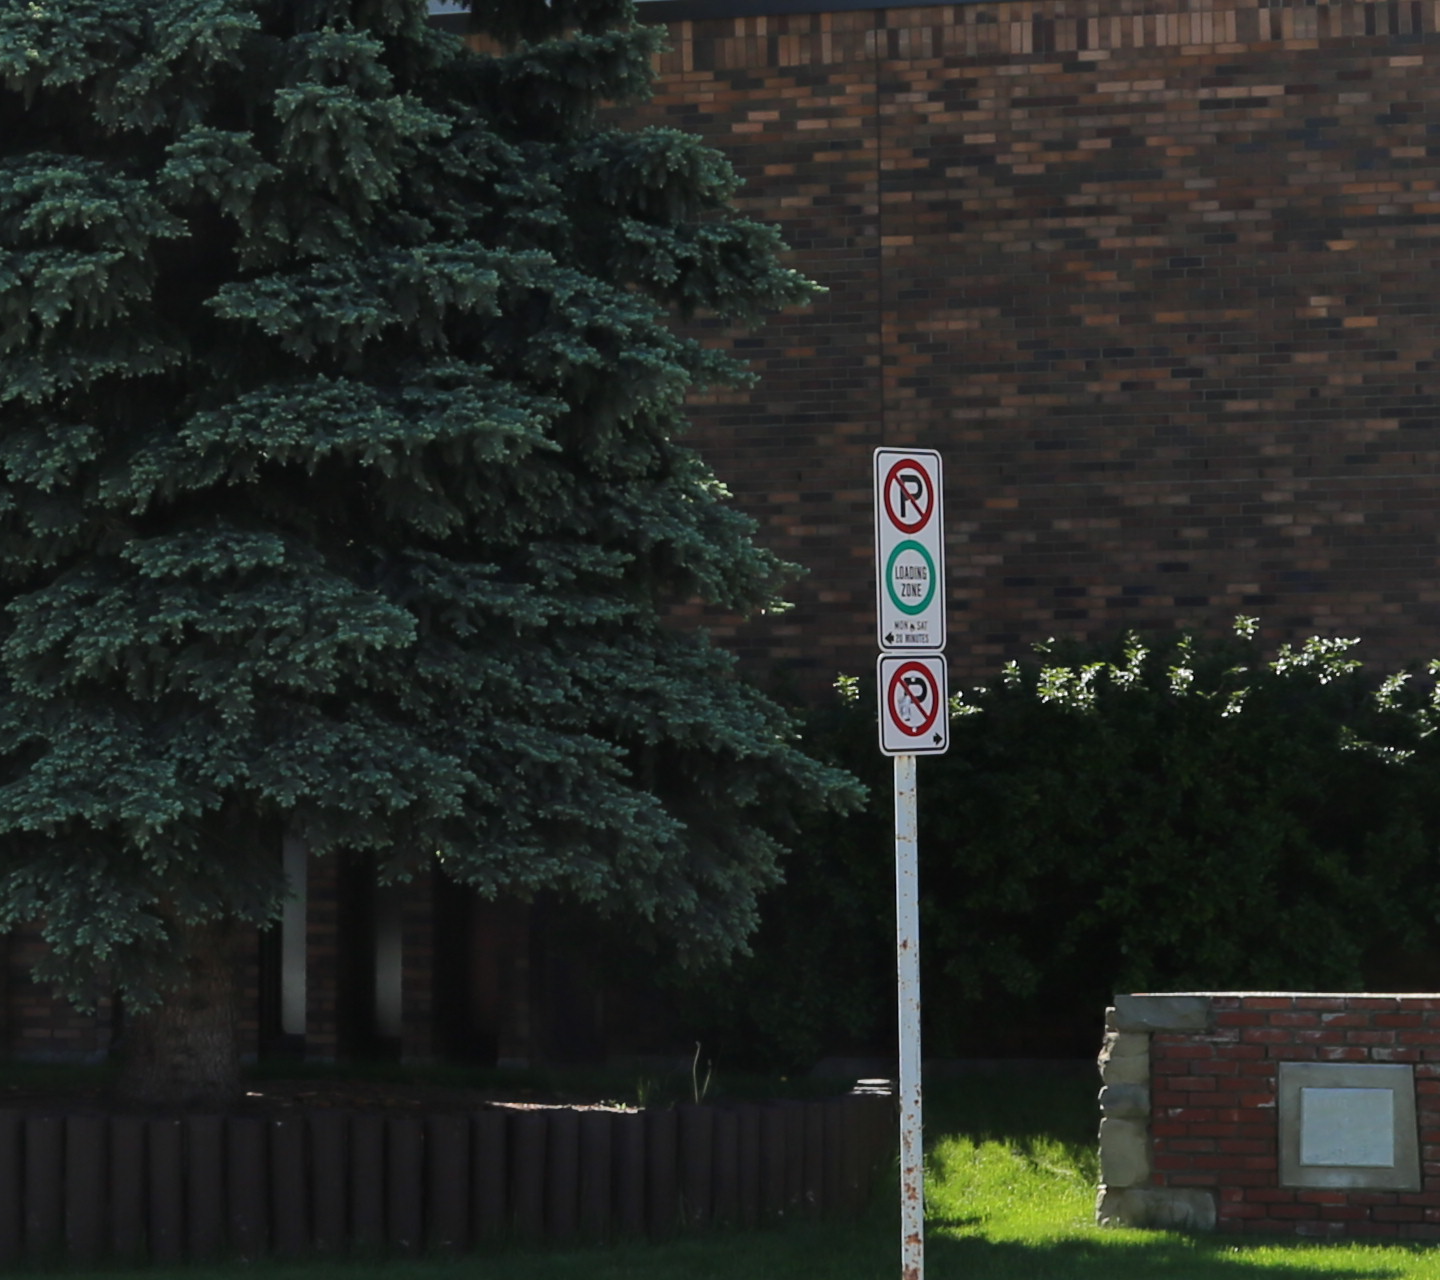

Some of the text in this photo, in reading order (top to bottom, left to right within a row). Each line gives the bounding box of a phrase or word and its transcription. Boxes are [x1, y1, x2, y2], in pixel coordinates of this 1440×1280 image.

[895, 566, 927, 580] LOADING
[901, 583, 922, 597] ZONE
[894, 620, 928, 630] MON SAT
[905, 633, 929, 643] MINUTES
